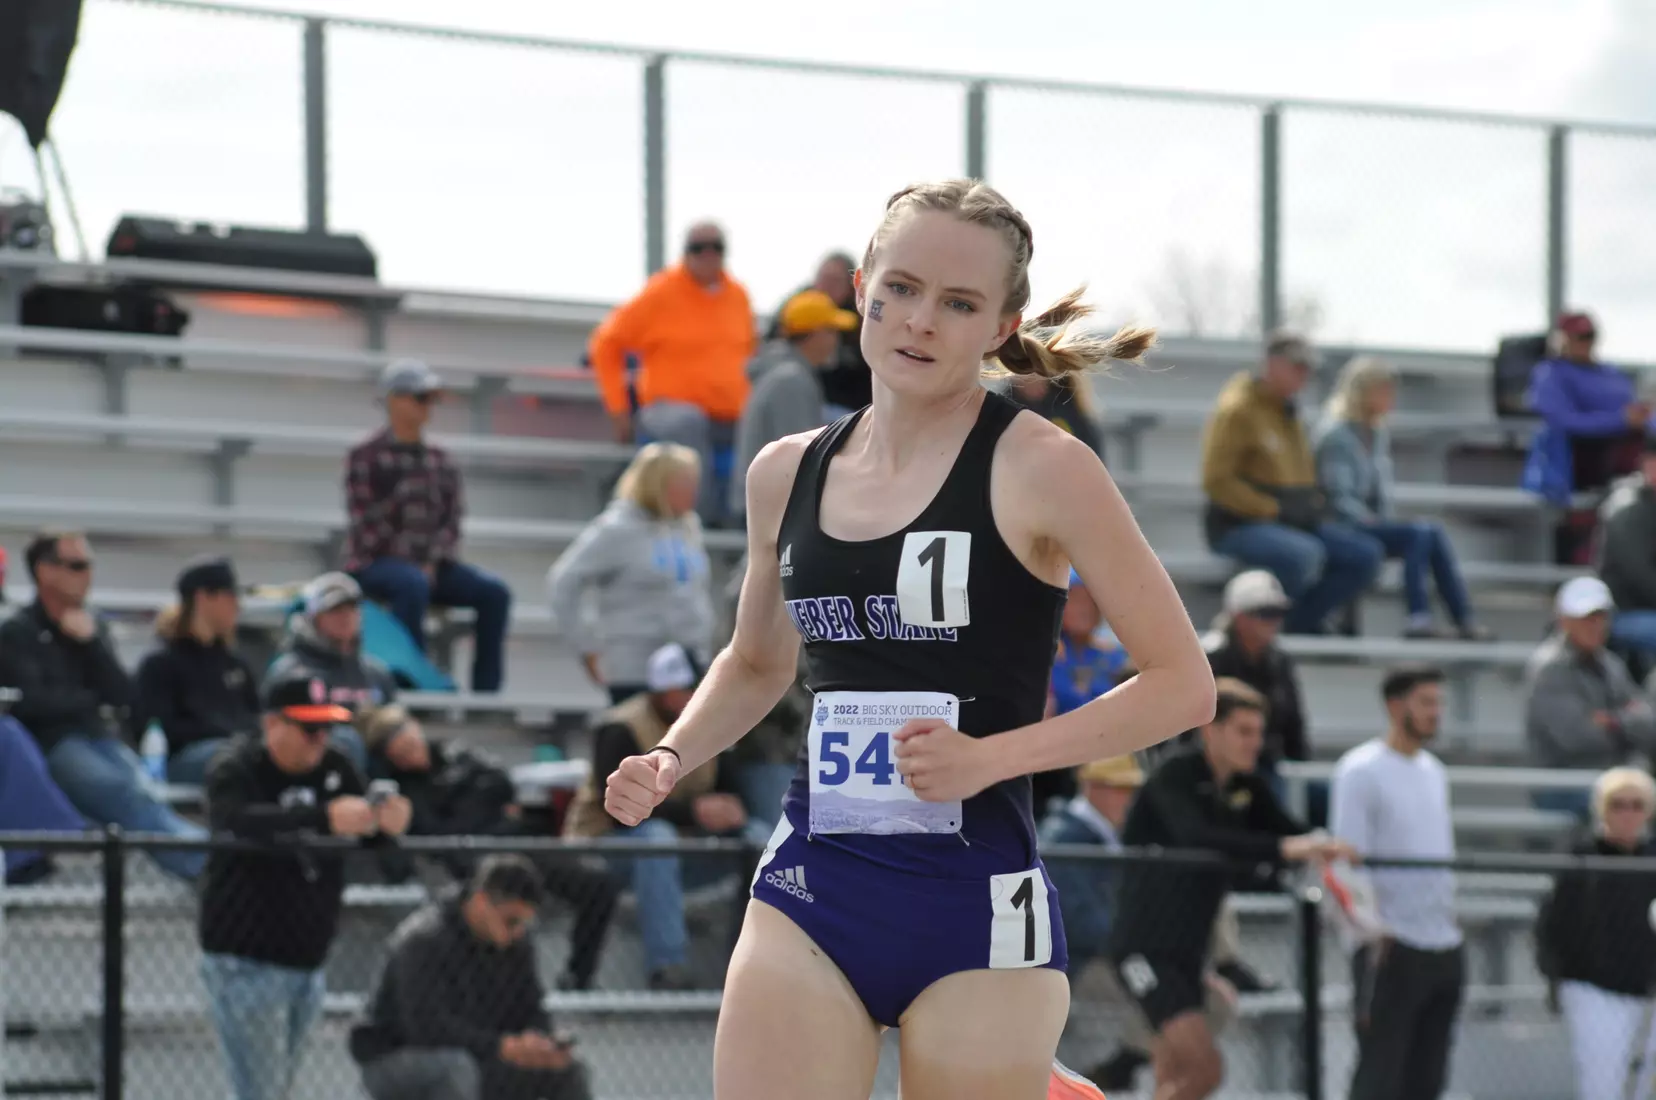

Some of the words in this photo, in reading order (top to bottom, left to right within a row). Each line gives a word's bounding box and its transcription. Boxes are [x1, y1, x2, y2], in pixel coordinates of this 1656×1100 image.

[917, 537, 947, 622] 1
[833, 704, 859, 714] 2022
[862, 704, 878, 715] BIG
[879, 704, 898, 715] SKY
[900, 705, 952, 716] OUTDOOR
[833, 717, 855, 726] TRACK
[863, 717, 884, 726] FIELD
[818, 731, 905, 786] 54
[764, 872, 815, 903] adidas
[1009, 876, 1036, 962] 1
